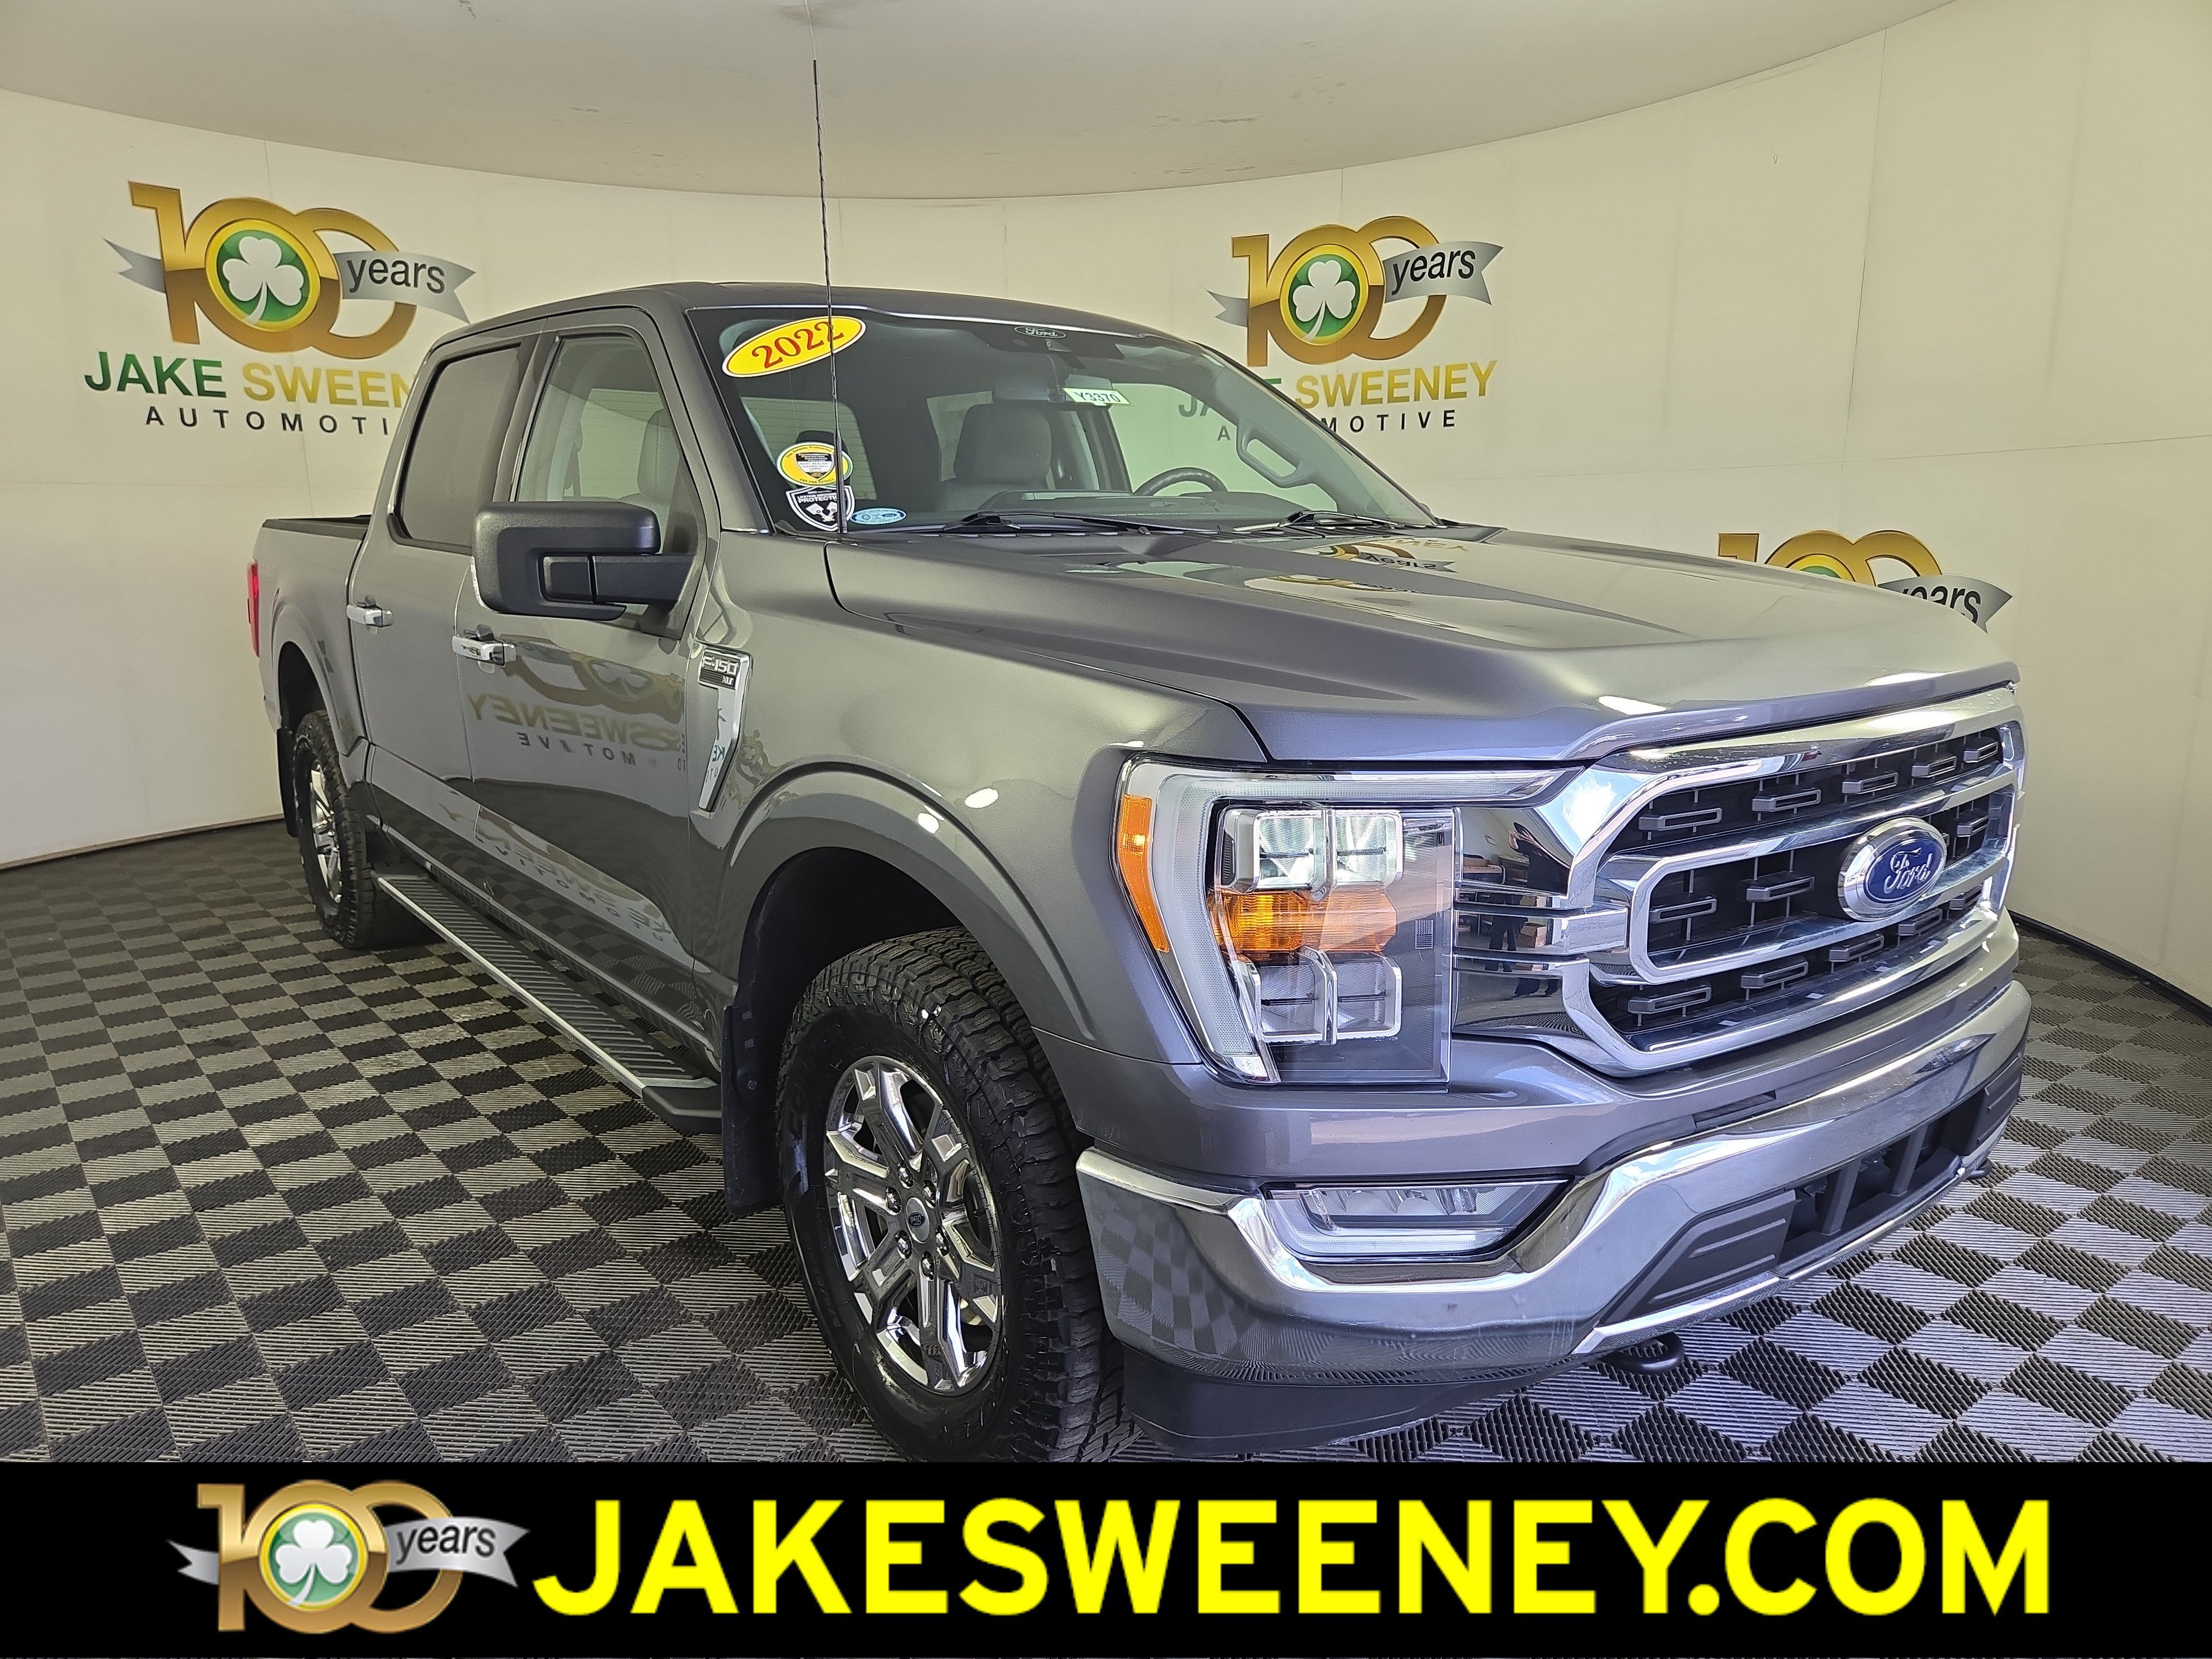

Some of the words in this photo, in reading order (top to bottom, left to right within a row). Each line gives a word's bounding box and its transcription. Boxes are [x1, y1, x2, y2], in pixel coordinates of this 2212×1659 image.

[346, 258, 446, 294] years
[1391, 249, 1476, 295] years
[751, 321, 845, 369] 2022
[1025, 326, 1058, 337] Ford
[85, 351, 227, 398] JAKE
[242, 362, 411, 408] SWEEN
[1073, 391, 1121, 403] Y3370
[1295, 360, 1498, 409] SWEENEY
[145, 406, 389, 436] AUTOMOTI
[702, 656, 739, 676] F-150
[1883, 847, 1933, 894] Ford
